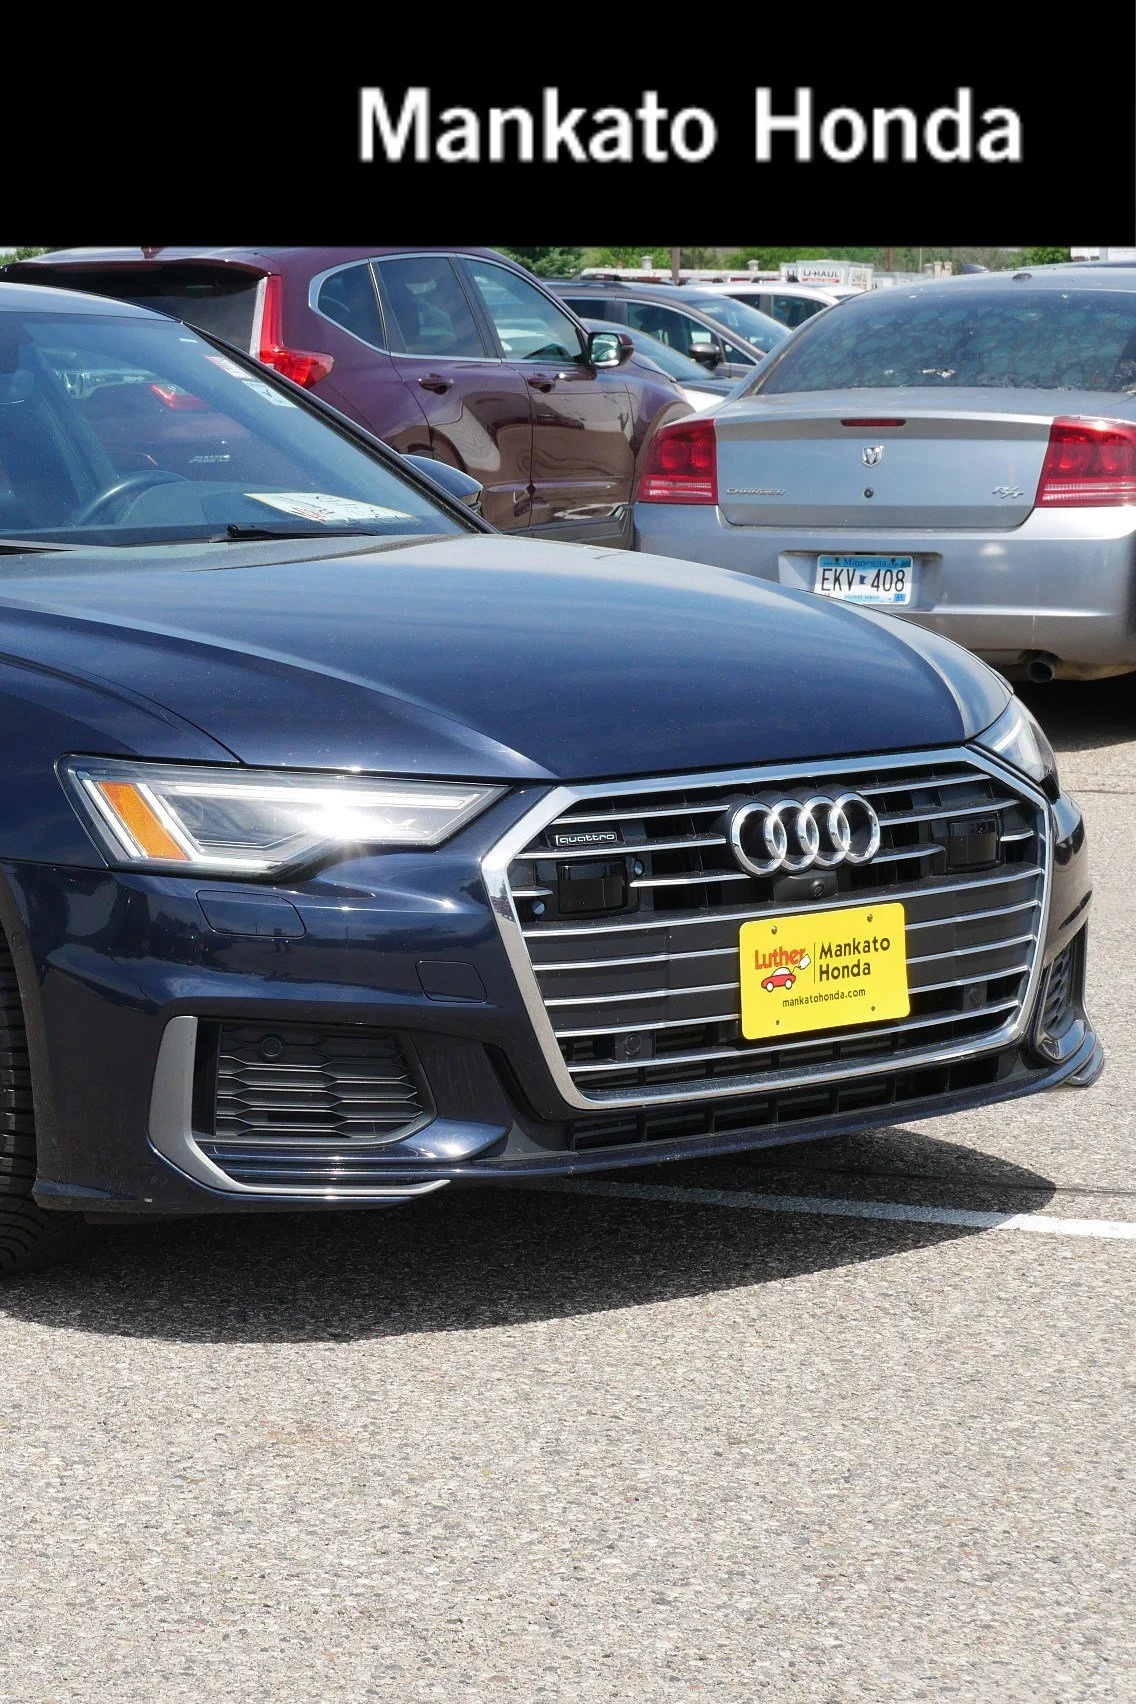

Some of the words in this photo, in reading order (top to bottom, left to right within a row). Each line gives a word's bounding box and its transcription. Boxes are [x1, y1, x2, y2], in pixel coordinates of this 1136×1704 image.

[843, 556, 887, 567] Minnesota
[821, 568, 856, 591] EKV
[870, 568, 906, 592] 408
[559, 834, 615, 844] quattro
[754, 945, 807, 971] Luther
[819, 936, 891, 960] Mankato
[819, 958, 871, 982] Honda
[782, 987, 866, 1008] mankatohonda.com
